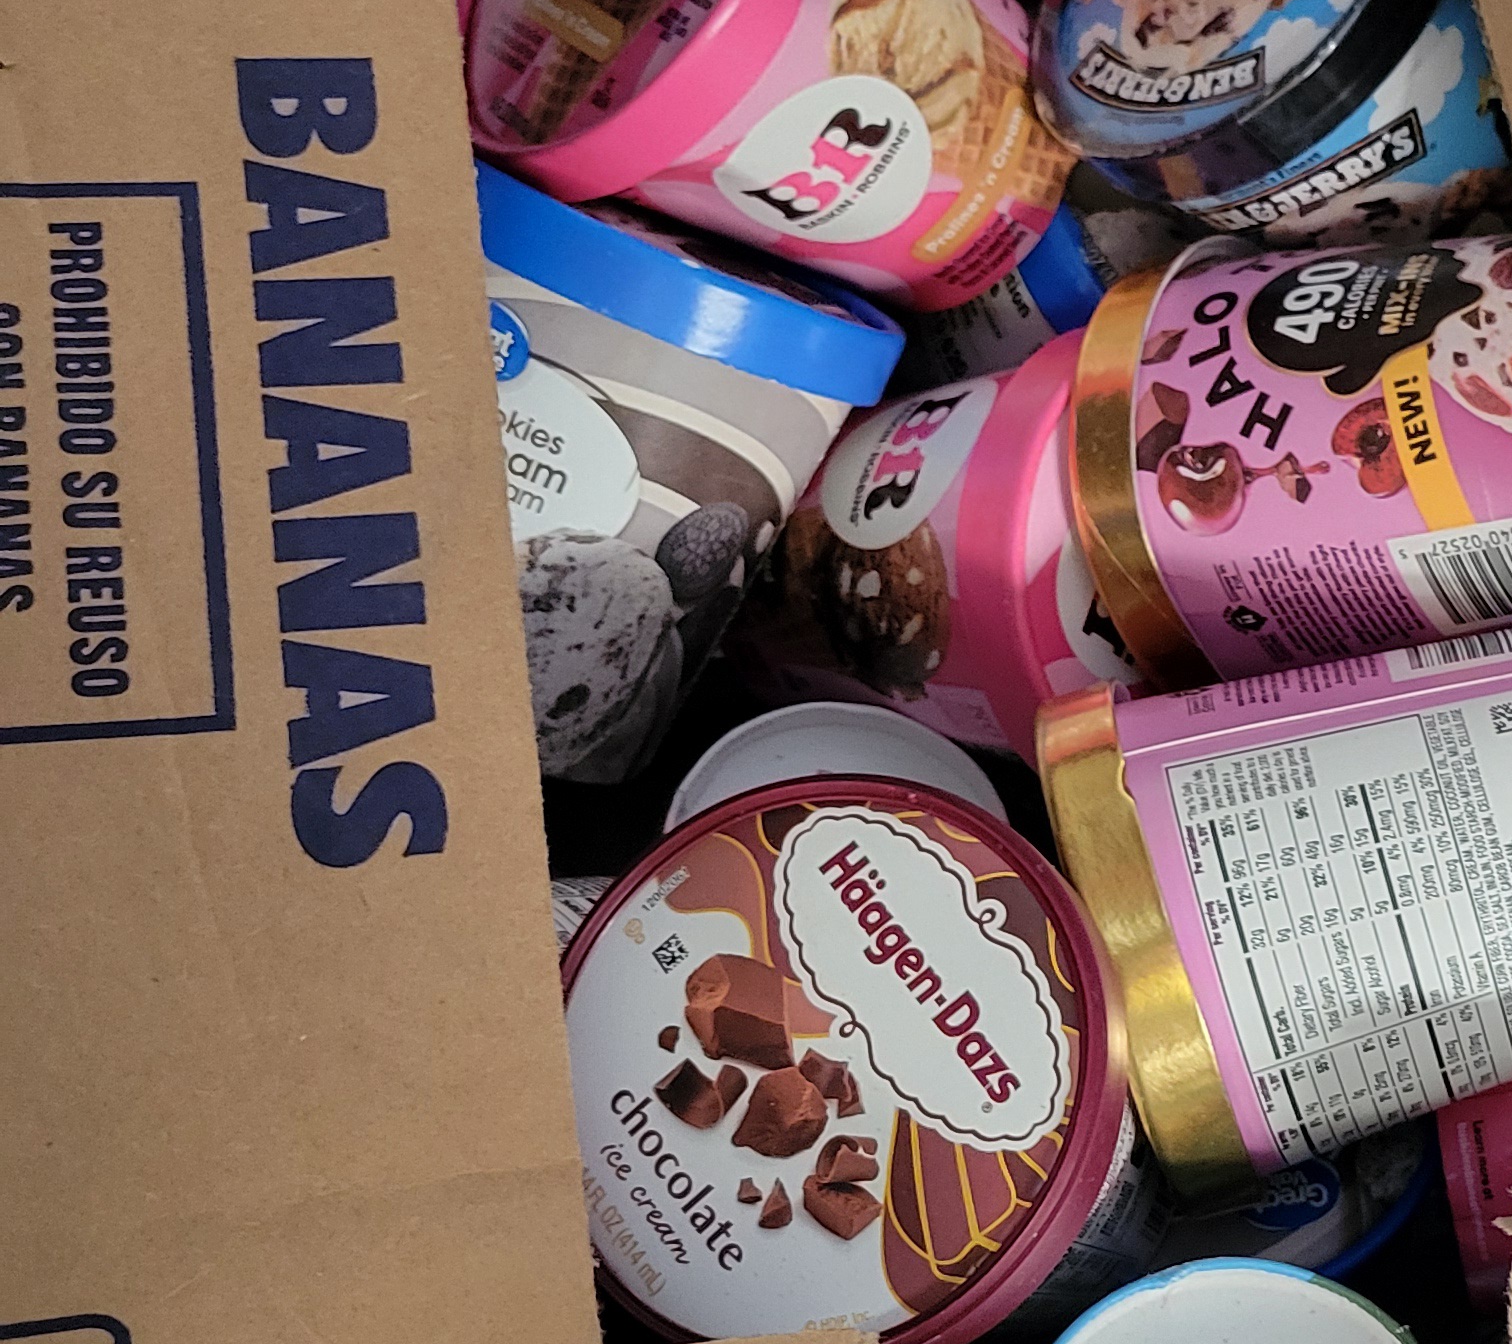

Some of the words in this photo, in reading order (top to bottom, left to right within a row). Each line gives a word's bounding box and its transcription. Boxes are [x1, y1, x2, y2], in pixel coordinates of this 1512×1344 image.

[856, 123, 910, 196] ROBBINS
[925, 192, 985, 258] Pralines
[989, 105, 1027, 170] Cream
[1272, 259, 1360, 345] 490
[48, 222, 120, 454] PROHIBIDO
[1188, 291, 1294, 452] HALO
[1394, 373, 1438, 465] NEW!
[235, 57, 448, 868] BANANAS
[62, 471, 122, 529] SU
[1399, 548, 1408, 560] 5
[1430, 534, 1482, 557] 02527
[65, 546, 129, 698] REUSO
[1422, 713, 1443, 754] VEGETABLE
[1367, 778, 1385, 801] 15%
[1391, 772, 1410, 795] 15%
[1422, 788, 1447, 828] 250mcg
[1352, 826, 1372, 848] 15g
[1376, 807, 1399, 841] 2.4mg
[1451, 811, 1470, 845] WATER,
[1278, 845, 1298, 867] 60g
[1303, 838, 1323, 861] 48g
[1327, 832, 1347, 854] 16g
[1384, 843, 1402, 862] 4%
[1409, 837, 1426, 855] 4%
[1433, 831, 1452, 854] 10%
[1229, 857, 1249, 880] 96g
[1254, 851, 1273, 873] 17g
[1358, 850, 1377, 874] 10%
[1460, 845, 1481, 881] CREAM,
[1236, 882, 1255, 907] 12%
[1260, 875, 1279, 901] 21%
[1321, 906, 1341, 928] 16g
[1347, 906, 1366, 922] 5g
[1372, 898, 1390, 915] 5g
[1274, 927, 1292, 943] 6g
[1296, 913, 1317, 936] 20g
[1248, 927, 1268, 950] 32g
[1328, 930, 1352, 966] Sugars
[1468, 950, 1482, 961] A
[818, 840, 1023, 1106] Häagen-Dazs
[1338, 964, 1359, 996] Added
[1361, 953, 1383, 990] Alcohol
[1471, 959, 1491, 992] Vitamin
[1291, 982, 1309, 1007] Fiber
[1315, 974, 1339, 1010] Sugars
[1371, 989, 1392, 1016] Sugar
[1271, 1005, 1290, 1033] Carb.
[1298, 1005, 1320, 1039] Dietary
[1324, 1008, 1342, 1031] Total
[1279, 1032, 1297, 1056] Total
[1472, 1119, 1487, 1154] Learn
[609, 1087, 748, 1272] chocolate
[1477, 1155, 1491, 1187] more
[600, 1141, 632, 1182] ice
[629, 1184, 691, 1267] cream
